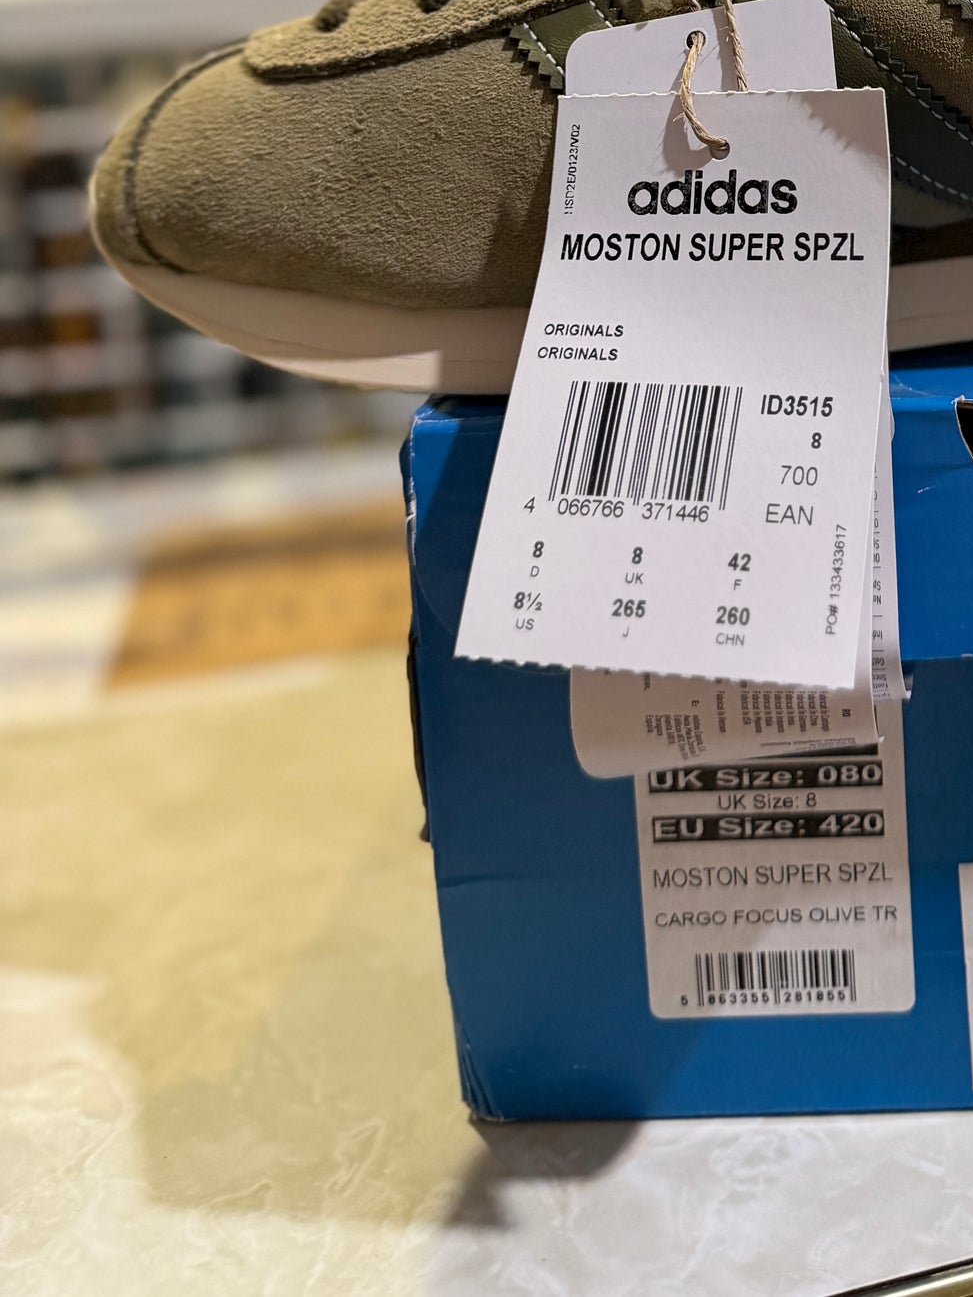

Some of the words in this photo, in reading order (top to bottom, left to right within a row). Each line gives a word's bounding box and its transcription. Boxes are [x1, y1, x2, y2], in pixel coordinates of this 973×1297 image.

[627, 169, 798, 216] adidas
[560, 233, 681, 261] MOSTON
[688, 233, 785, 261] SUPER
[793, 233, 864, 261] SPZL
[543, 323, 624, 338] ORIGINALS
[537, 346, 618, 361] ORIGINALS
[760, 394, 833, 417] ID3515
[811, 432, 822, 449] 8
[780, 465, 818, 486] 700
[524, 496, 536, 514] 4
[557, 499, 625, 518] 066766
[642, 502, 709, 523] 371446
[765, 503, 814, 526] EAN
[532, 541, 544, 559] 8
[631, 547, 643, 565] 8
[727, 553, 752, 572] 42
[829, 524, 847, 599] 133433617
[530, 566, 540, 578] D
[625, 572, 644, 584] UK
[733, 579, 742, 591] F
[611, 598, 646, 618] 265
[715, 606, 750, 627] 260
[516, 618, 534, 631] US
[825, 604, 838, 635] PO#
[622, 626, 630, 639] J
[715, 632, 745, 646] CHN
[650, 768, 703, 789] UK
[716, 766, 804, 786] Size:
[817, 764, 882, 784] 080
[717, 794, 747, 810] UK
[753, 793, 800, 809] Size:
[806, 792, 817, 807] 8
[654, 818, 704, 839] EU
[717, 816, 806, 837] Size:
[818, 813, 884, 834] 420
[653, 867, 748, 889] MOSTON
[755, 864, 832, 885] SUPER
[838, 862, 893, 882] SPZL
[655, 910, 727, 927] CARGO
[733, 908, 802, 925] FOCUS
[809, 906, 866, 923] OLIVE
[872, 905, 898, 921] TR
